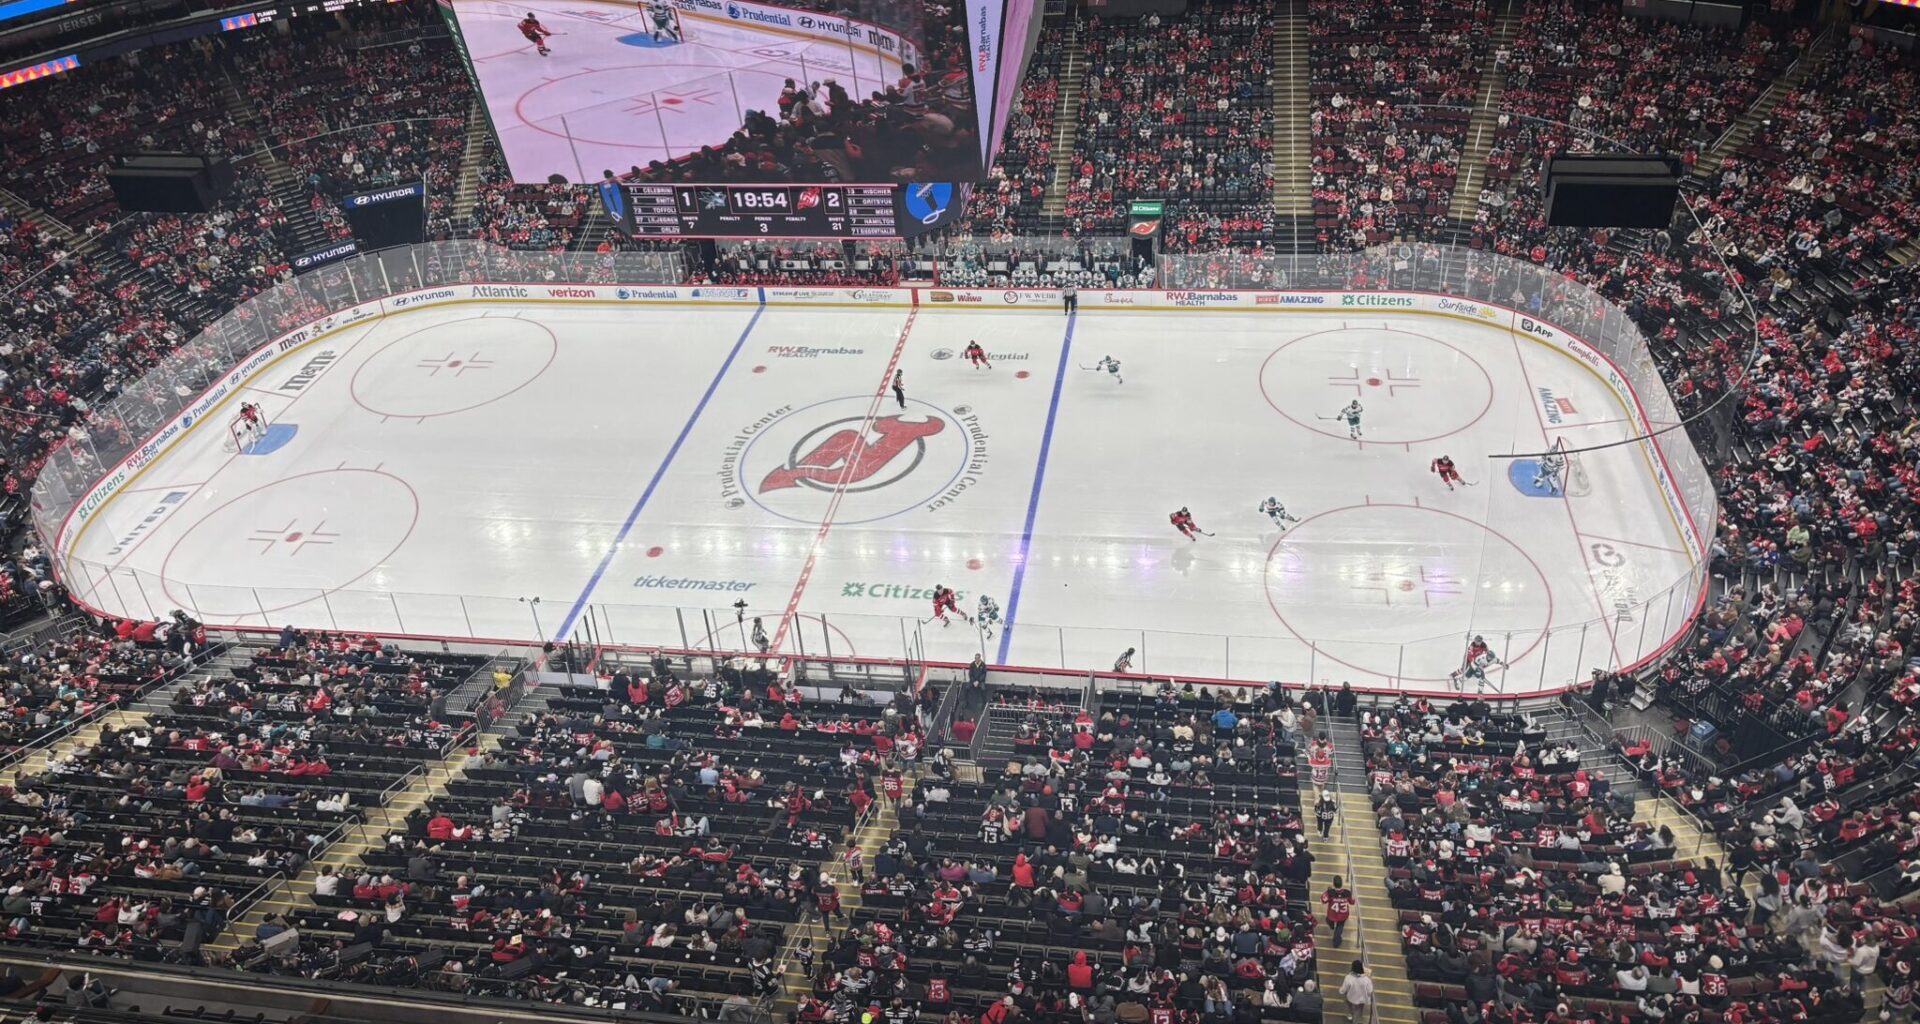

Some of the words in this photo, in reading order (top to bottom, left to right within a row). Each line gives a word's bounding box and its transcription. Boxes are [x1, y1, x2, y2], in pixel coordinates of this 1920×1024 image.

[57, 13, 103, 35] JERSEY
[742, 8, 792, 27] Prudential
[817, 21, 862, 39] HYUNDAI
[372, 187, 415, 202] HYUNDAI
[682, 192, 690, 206] 1
[734, 192, 788, 207] 19:54
[827, 192, 840, 207] 2
[760, 223, 768, 233] 3
[312, 243, 355, 262] HYUNDAI
[411, 290, 454, 302] HYUNDAI
[472, 286, 528, 298] Atlantic
[548, 288, 595, 298] verizon
[632, 288, 678, 299] Prudential
[958, 292, 982, 302] Wawa
[1166, 291, 1238, 301] RWJBarnabas
[1280, 296, 1324, 304] AMAZING
[1357, 294, 1413, 306] Citizens
[1439, 298, 1477, 314] Surfside
[768, 345, 864, 356] RWJBarnabas
[241, 349, 274, 376] HYUNDAI
[192, 384, 228, 418] Prudential
[126, 424, 178, 470] RWJBarnabas
[717, 435, 745, 499] Prudential
[743, 403, 793, 440] Center
[962, 413, 990, 476] Prudential
[85, 471, 126, 511] Citizens
[926, 476, 977, 513] Center
[107, 506, 167, 556] UNITED
[633, 574, 756, 593] ticketmaster
[868, 583, 966, 602] Citizes
[884, 780, 898, 791] 86
[1061, 800, 1074, 812] 13
[984, 832, 997, 844] 13
[1538, 836, 1555, 848] 28
[1331, 903, 1348, 914] 43
[1709, 982, 1725, 995] 36
